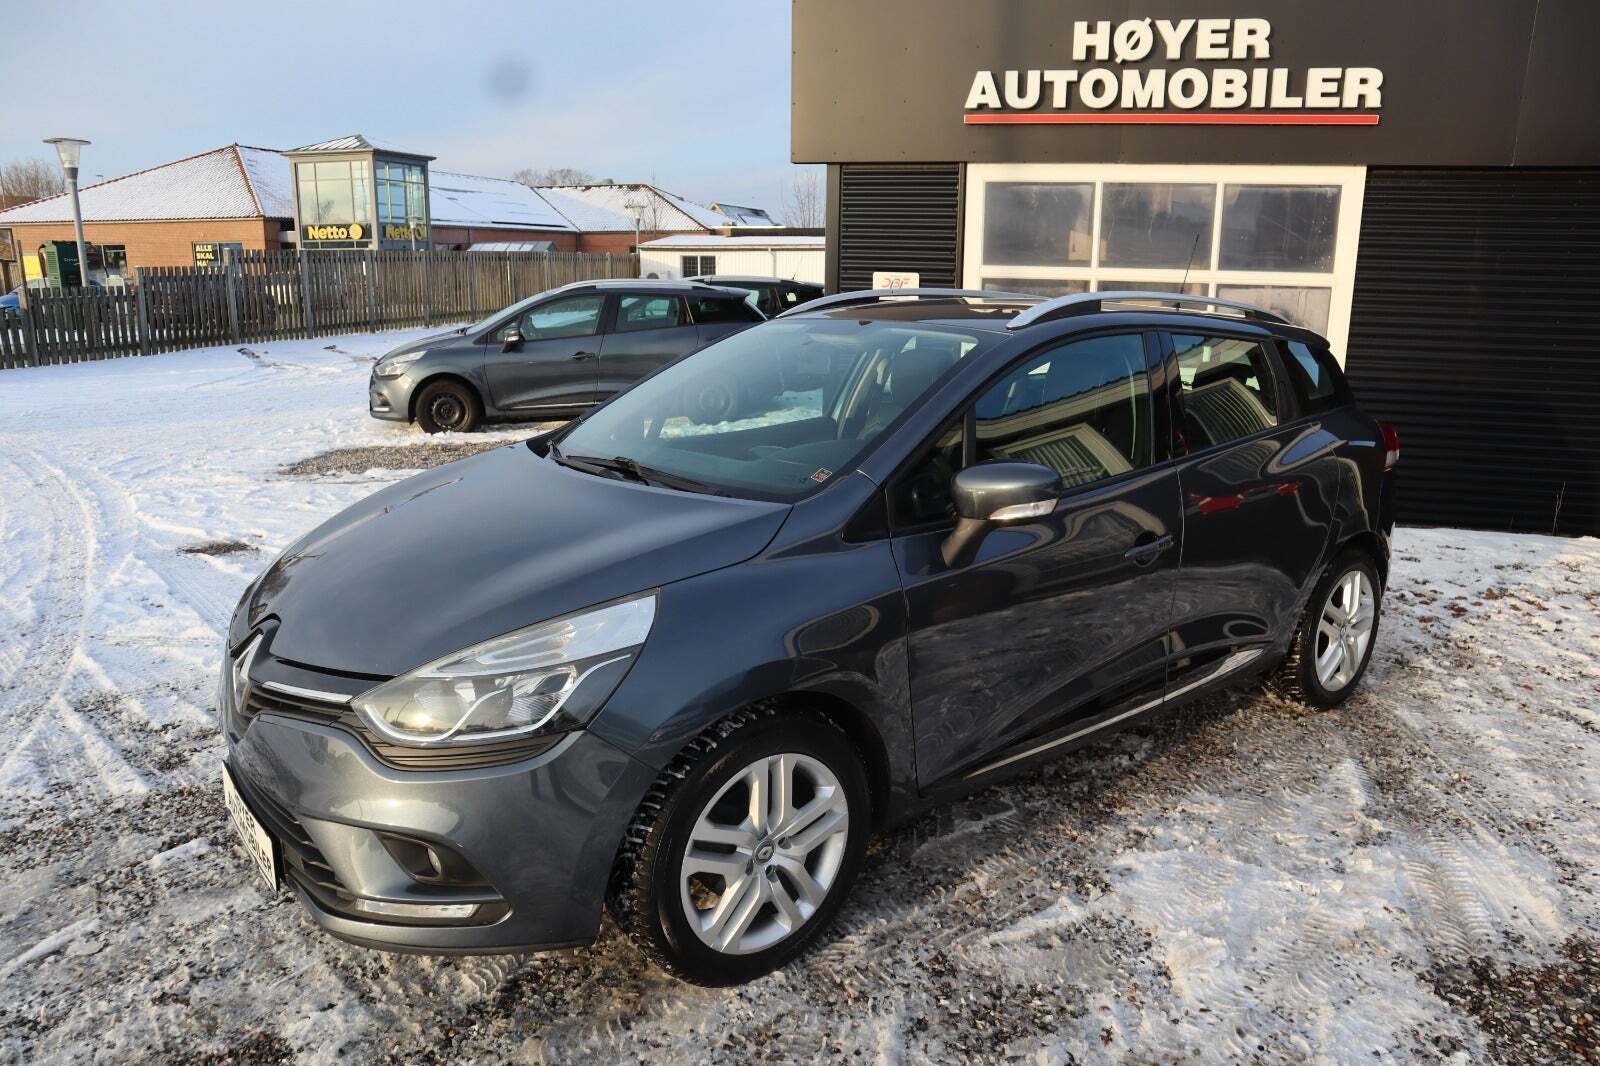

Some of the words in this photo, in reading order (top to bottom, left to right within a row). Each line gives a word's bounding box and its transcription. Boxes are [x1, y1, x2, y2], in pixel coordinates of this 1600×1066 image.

[1072, 17, 1271, 65] HØYER
[964, 67, 1384, 109] AUTOMOBILER
[308, 225, 347, 239] Netto
[196, 252, 214, 260] SKAL
